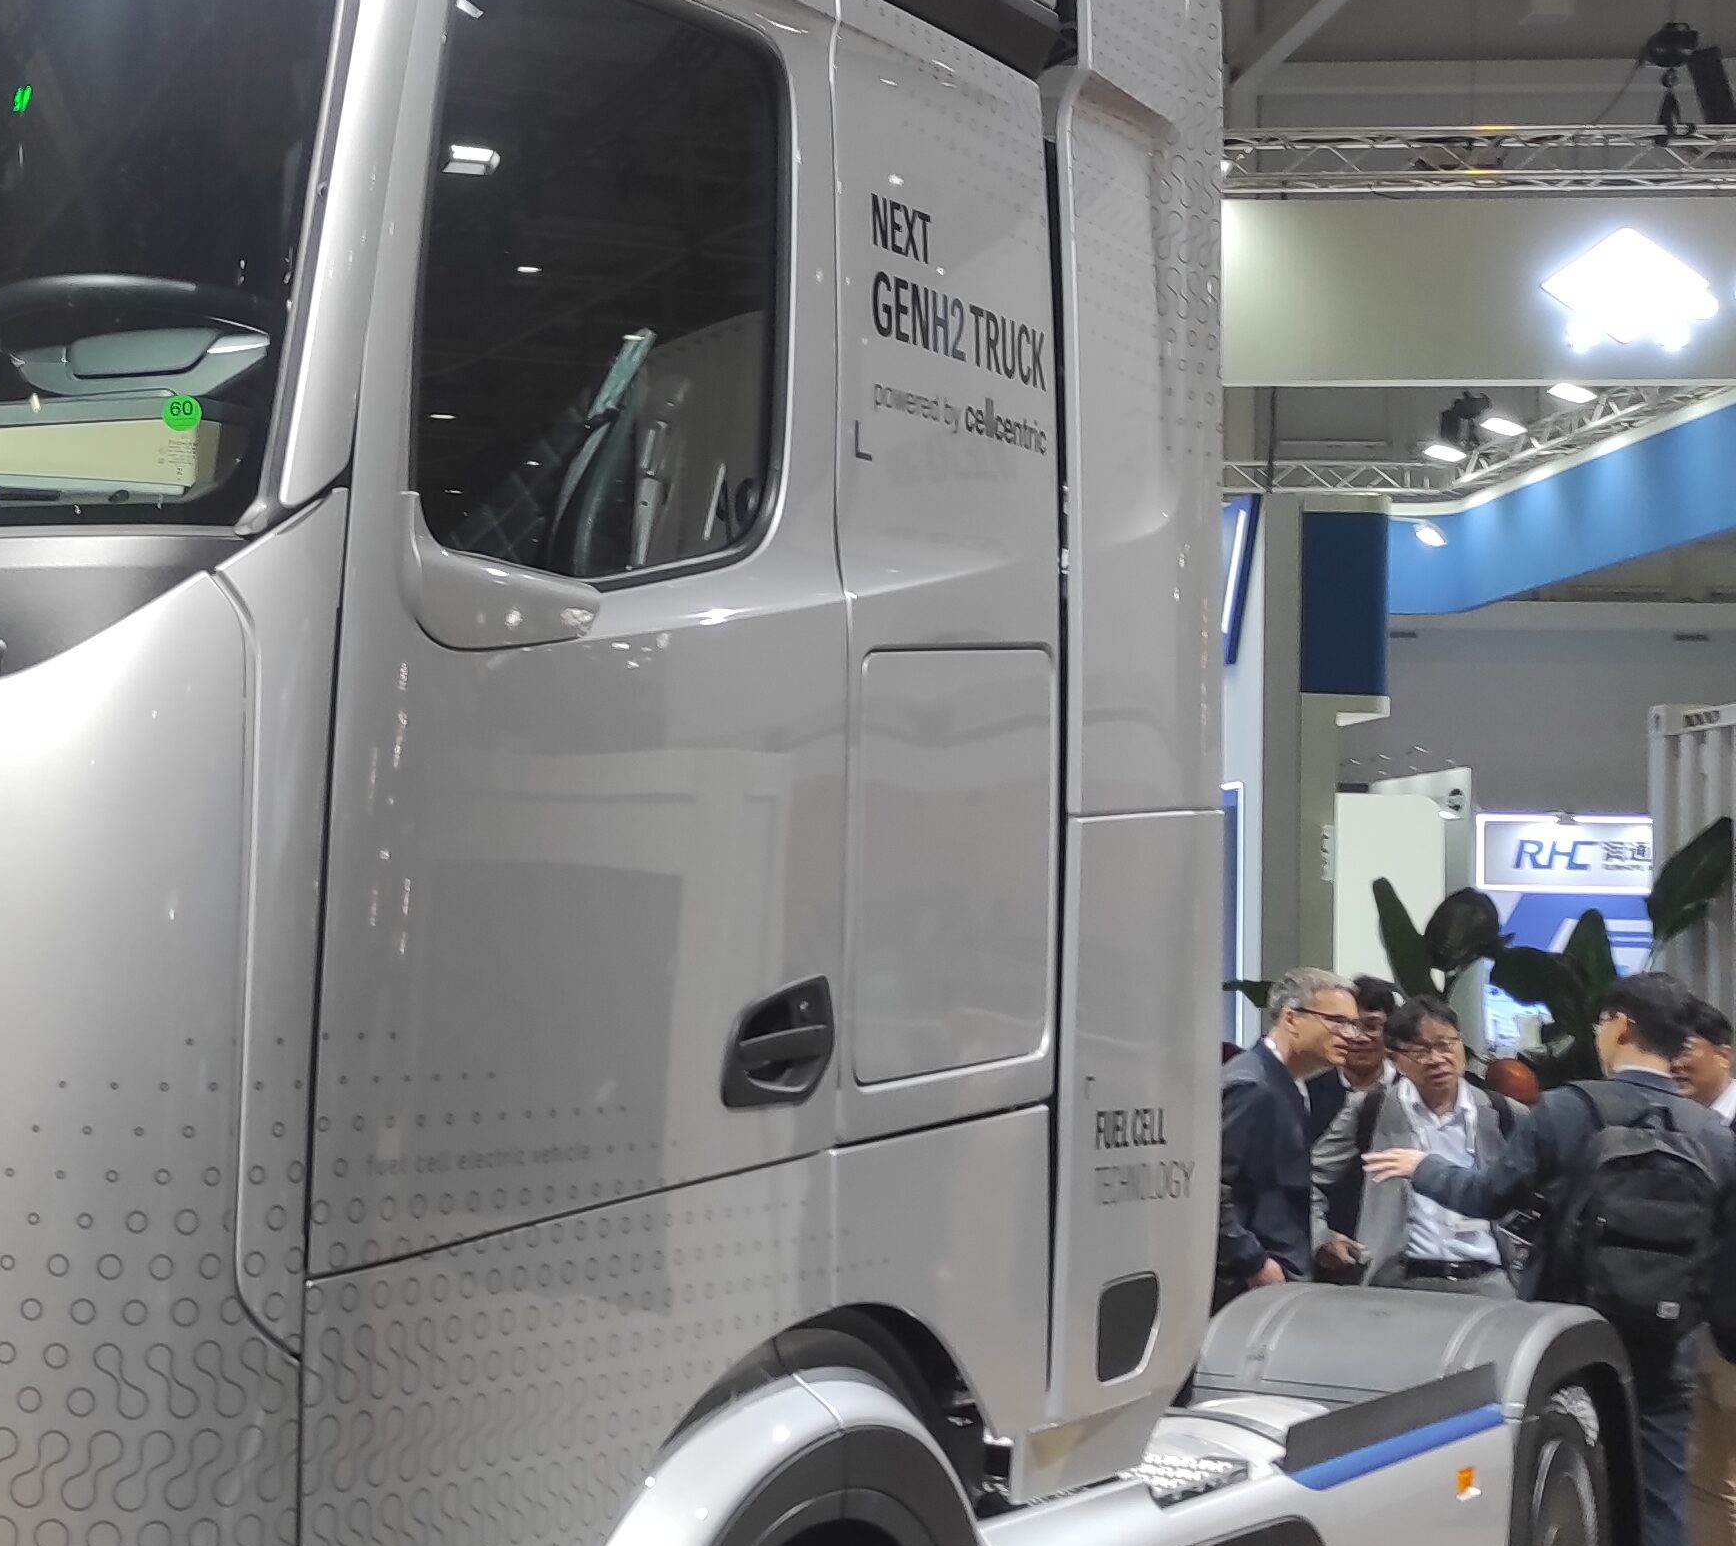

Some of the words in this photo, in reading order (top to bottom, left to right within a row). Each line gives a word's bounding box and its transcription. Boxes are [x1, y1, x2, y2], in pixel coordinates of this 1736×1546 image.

[871, 192, 931, 264] NEXT
[872, 271, 966, 362] GENH2
[970, 303, 1047, 392] TRUCK
[169, 400, 194, 417] 60
[874, 383, 940, 422] powered
[943, 396, 960, 434] by
[965, 397, 1047, 456] cellcentric
[1095, 1110, 1129, 1149] FUEL
